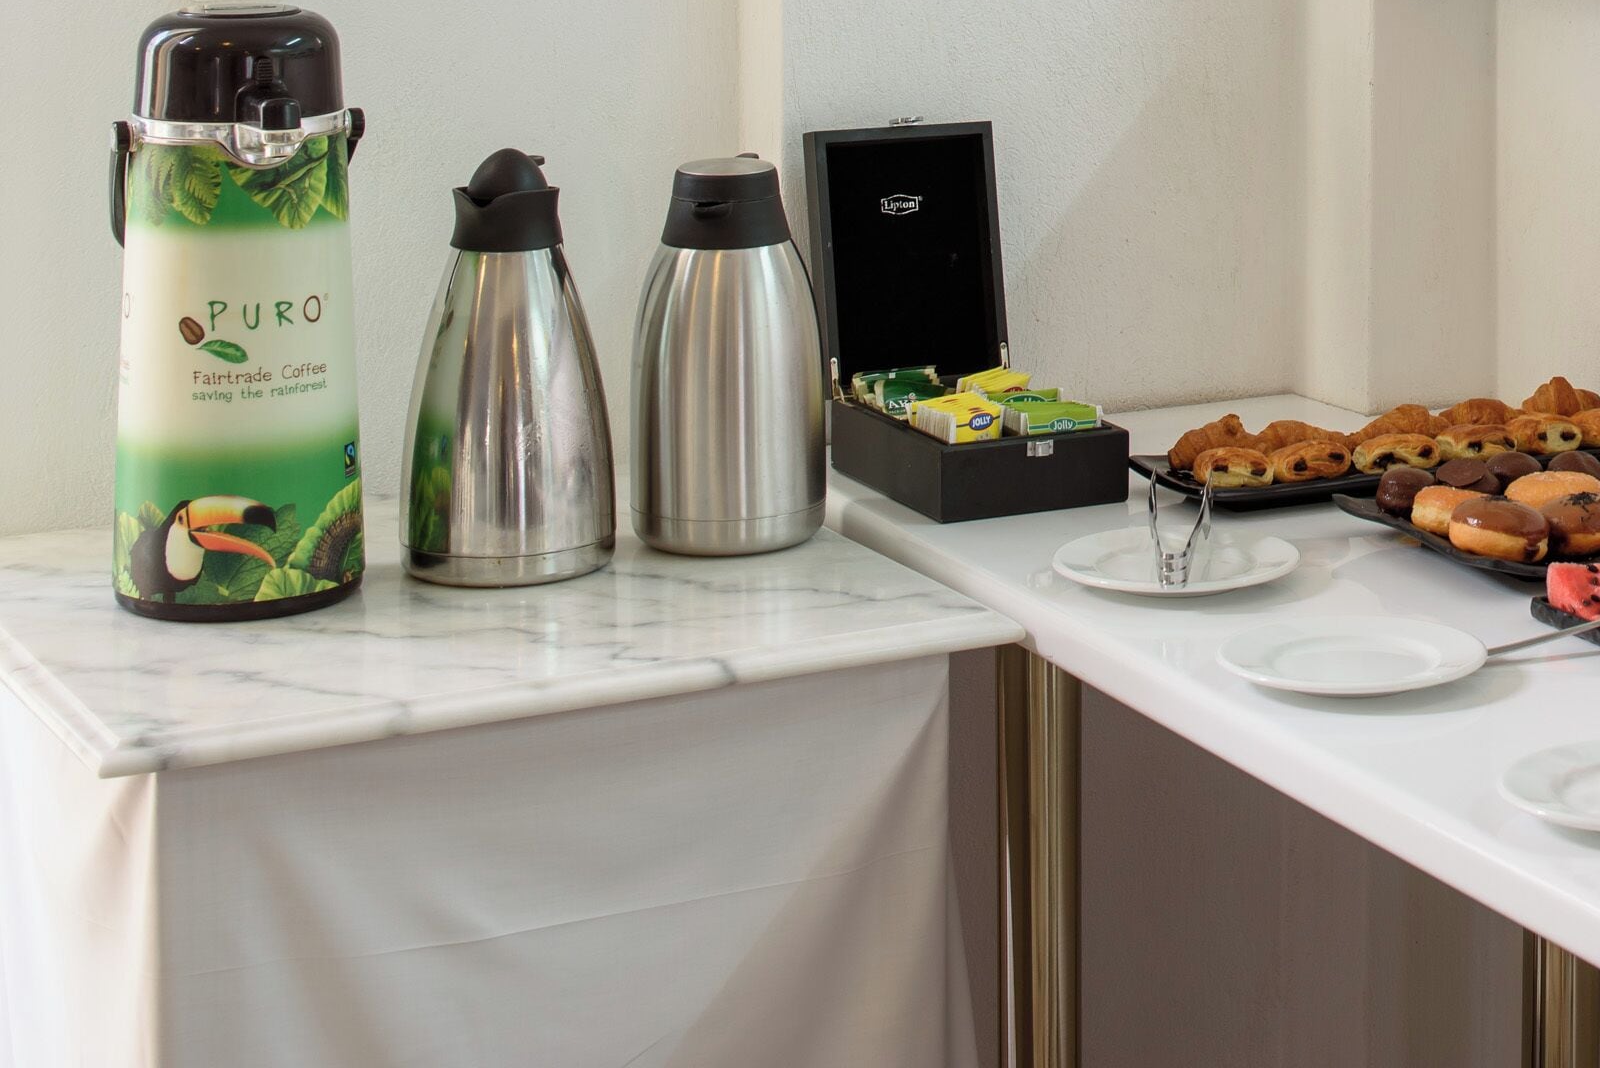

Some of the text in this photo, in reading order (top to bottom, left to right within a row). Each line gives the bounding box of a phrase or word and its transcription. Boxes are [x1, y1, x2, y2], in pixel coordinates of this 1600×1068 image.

[884, 201, 915, 211] Lipton
[207, 295, 321, 332] PURO
[193, 363, 327, 385] Fairtrade Coffee
[192, 378, 327, 403] saving the rainforest
[972, 416, 992, 428] JOLLY
[1053, 419, 1073, 431] Jolly
